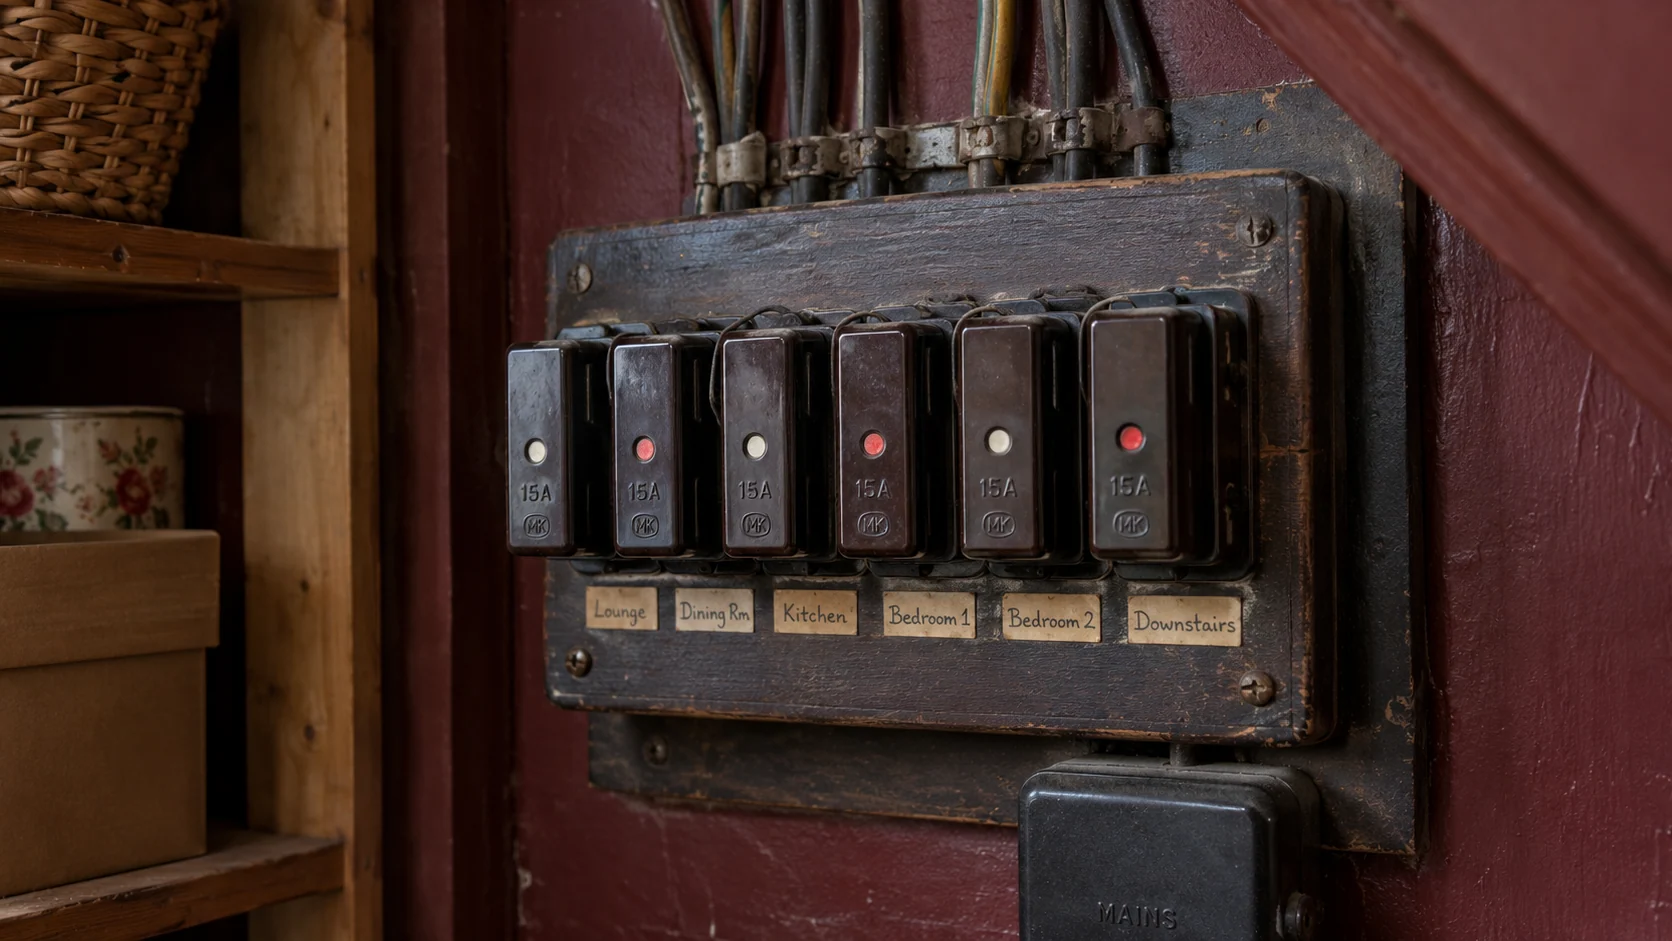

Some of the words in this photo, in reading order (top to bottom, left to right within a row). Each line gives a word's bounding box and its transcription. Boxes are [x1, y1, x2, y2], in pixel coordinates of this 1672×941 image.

[519, 483, 552, 502] 15A
[628, 482, 661, 501] 15A
[738, 480, 772, 500] 15A
[855, 478, 893, 499] 15A
[979, 477, 1017, 498] 15A
[1110, 475, 1152, 497] 15A
[526, 516, 548, 535] MK
[635, 516, 659, 535] MK
[745, 516, 768, 535] MK
[862, 515, 887, 533] MK
[987, 515, 1012, 533] MK
[1118, 515, 1145, 533] MK
[594, 599, 646, 626] Lounge
[680, 601, 726, 628] Dining
[729, 602, 750, 622] Rm
[783, 603, 848, 624] Kitchen
[889, 604, 958, 626] Bedroom
[961, 609, 971, 626] 1
[1008, 607, 1080, 629] Bedroom
[1084, 611, 1096, 630] 2
[1133, 610, 1236, 633] Downstairs
[1098, 901, 1177, 930] MAINS
